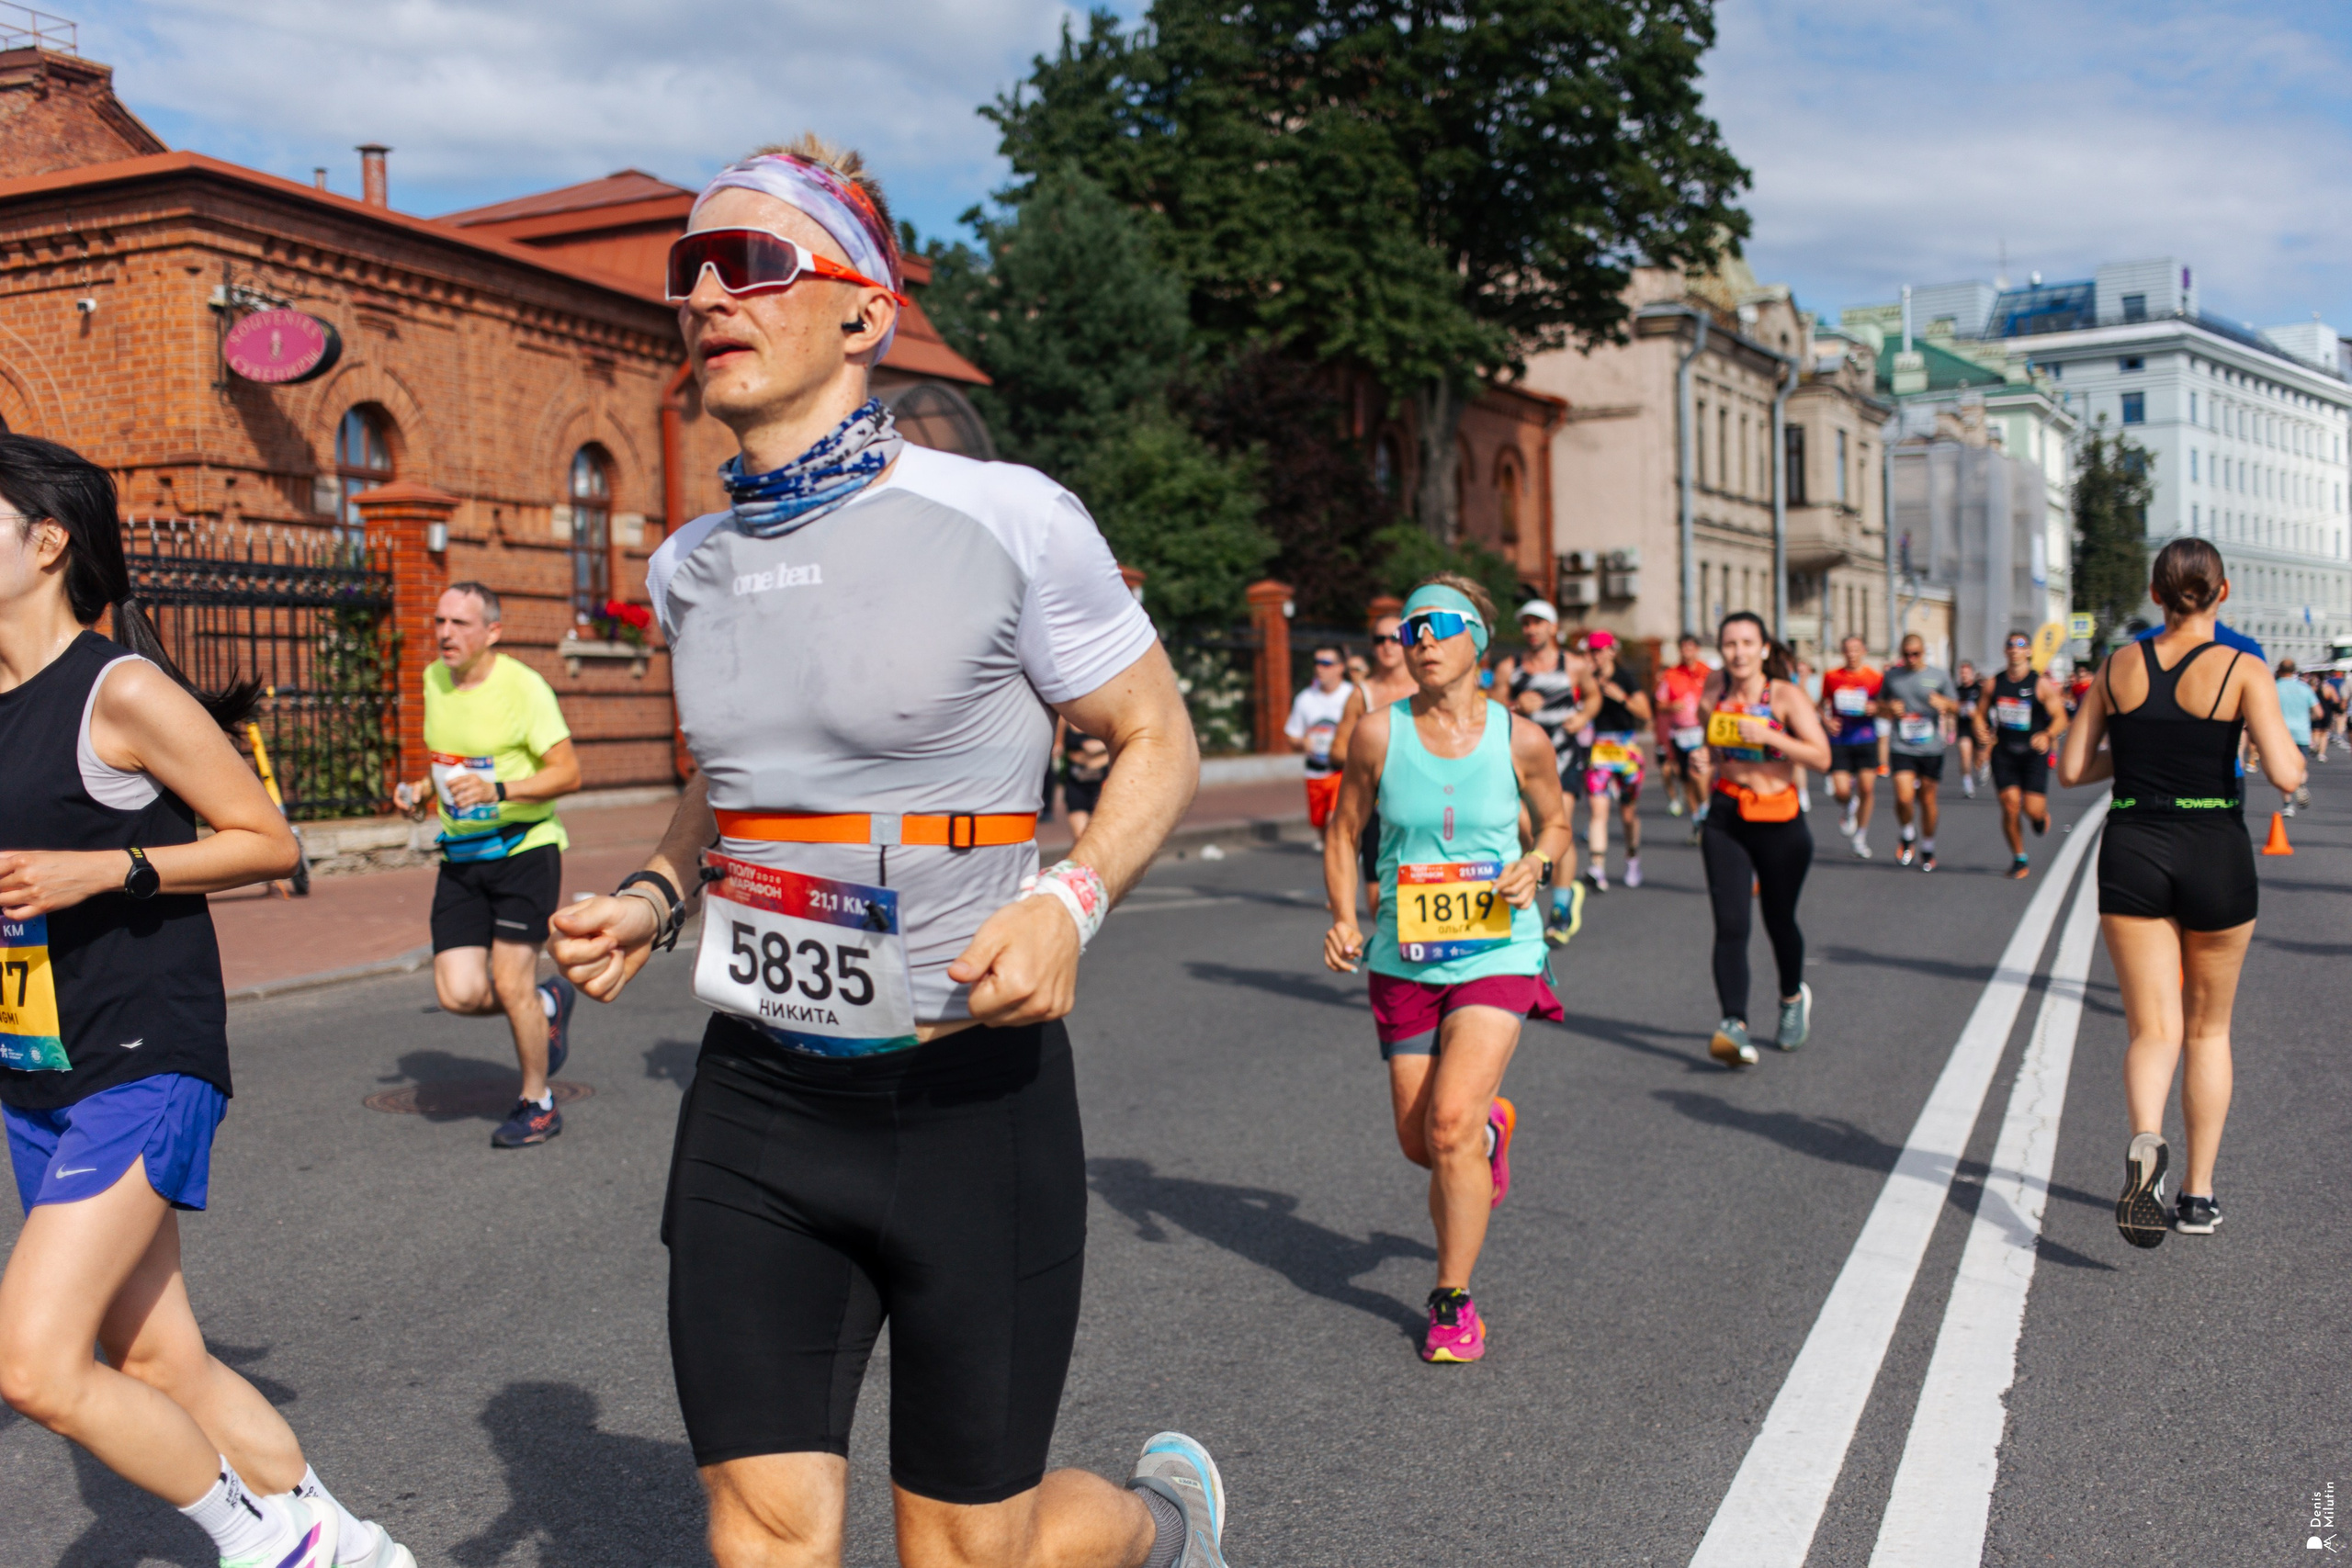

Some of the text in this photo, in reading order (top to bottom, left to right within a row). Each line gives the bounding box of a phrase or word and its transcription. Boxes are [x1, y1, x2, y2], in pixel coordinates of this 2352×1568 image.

[729, 876, 782, 899] МАРАФОН
[809, 889, 838, 912] 21,1
[1415, 891, 1494, 922] 1819
[3, 924, 24, 937] КМ
[1438, 924, 1471, 934] ОЛЬГА
[729, 920, 875, 1006] 5835
[1409, 943, 1424, 961] D
[759, 998, 840, 1025] НИКИТА
